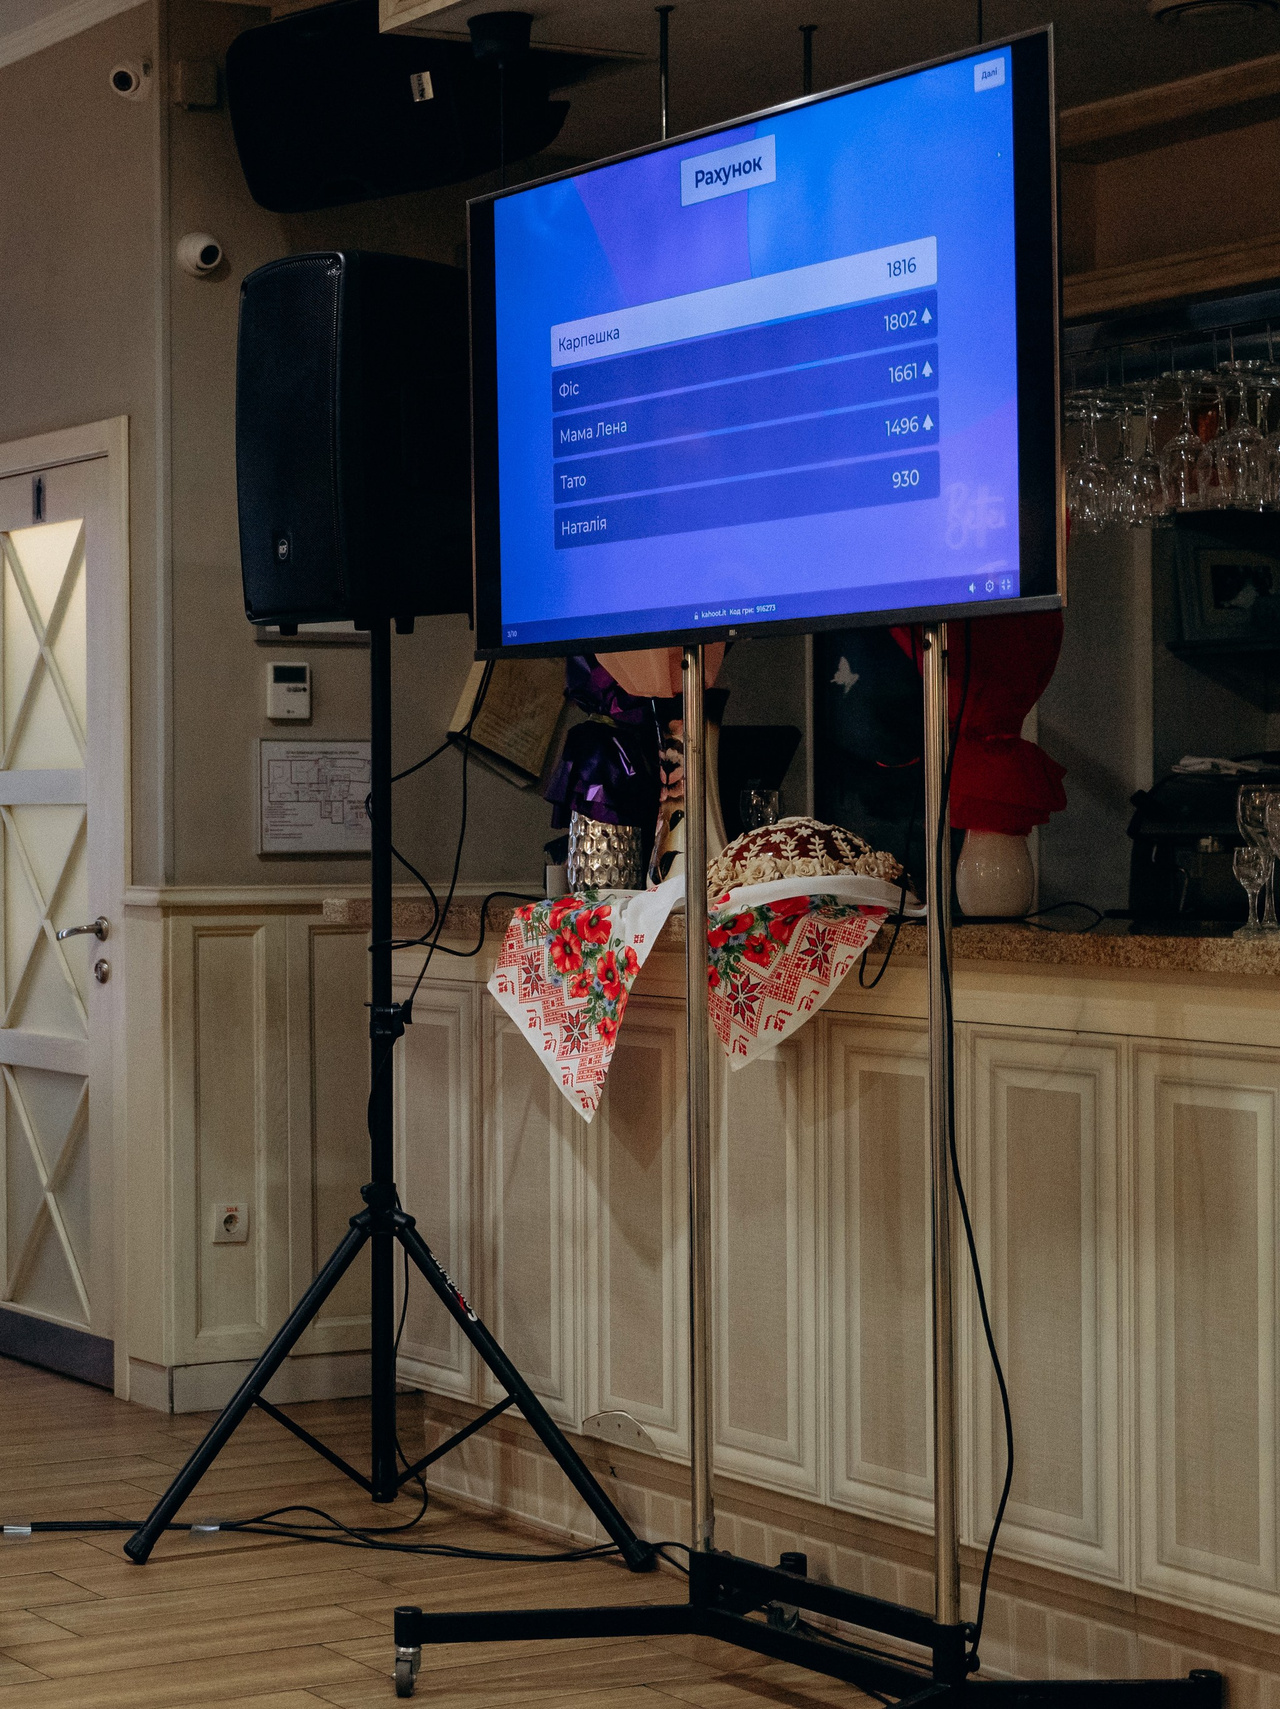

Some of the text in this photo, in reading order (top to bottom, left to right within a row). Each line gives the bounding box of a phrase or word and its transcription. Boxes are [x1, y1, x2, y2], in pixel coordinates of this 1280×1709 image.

[981, 66, 998, 80] Далі
[694, 156, 763, 188] Рахунок
[886, 256, 917, 278] 1816
[883, 310, 918, 331] 1802
[558, 327, 620, 352] Карпешка
[888, 362, 918, 384] 1661
[558, 380, 580, 398] Фіс
[560, 421, 628, 444] Мама Лена
[885, 415, 919, 437] 1496
[560, 474, 587, 490] Тато
[892, 469, 920, 489] 930
[561, 515, 608, 536] Наталія
[701, 608, 727, 618] kahoot.it
